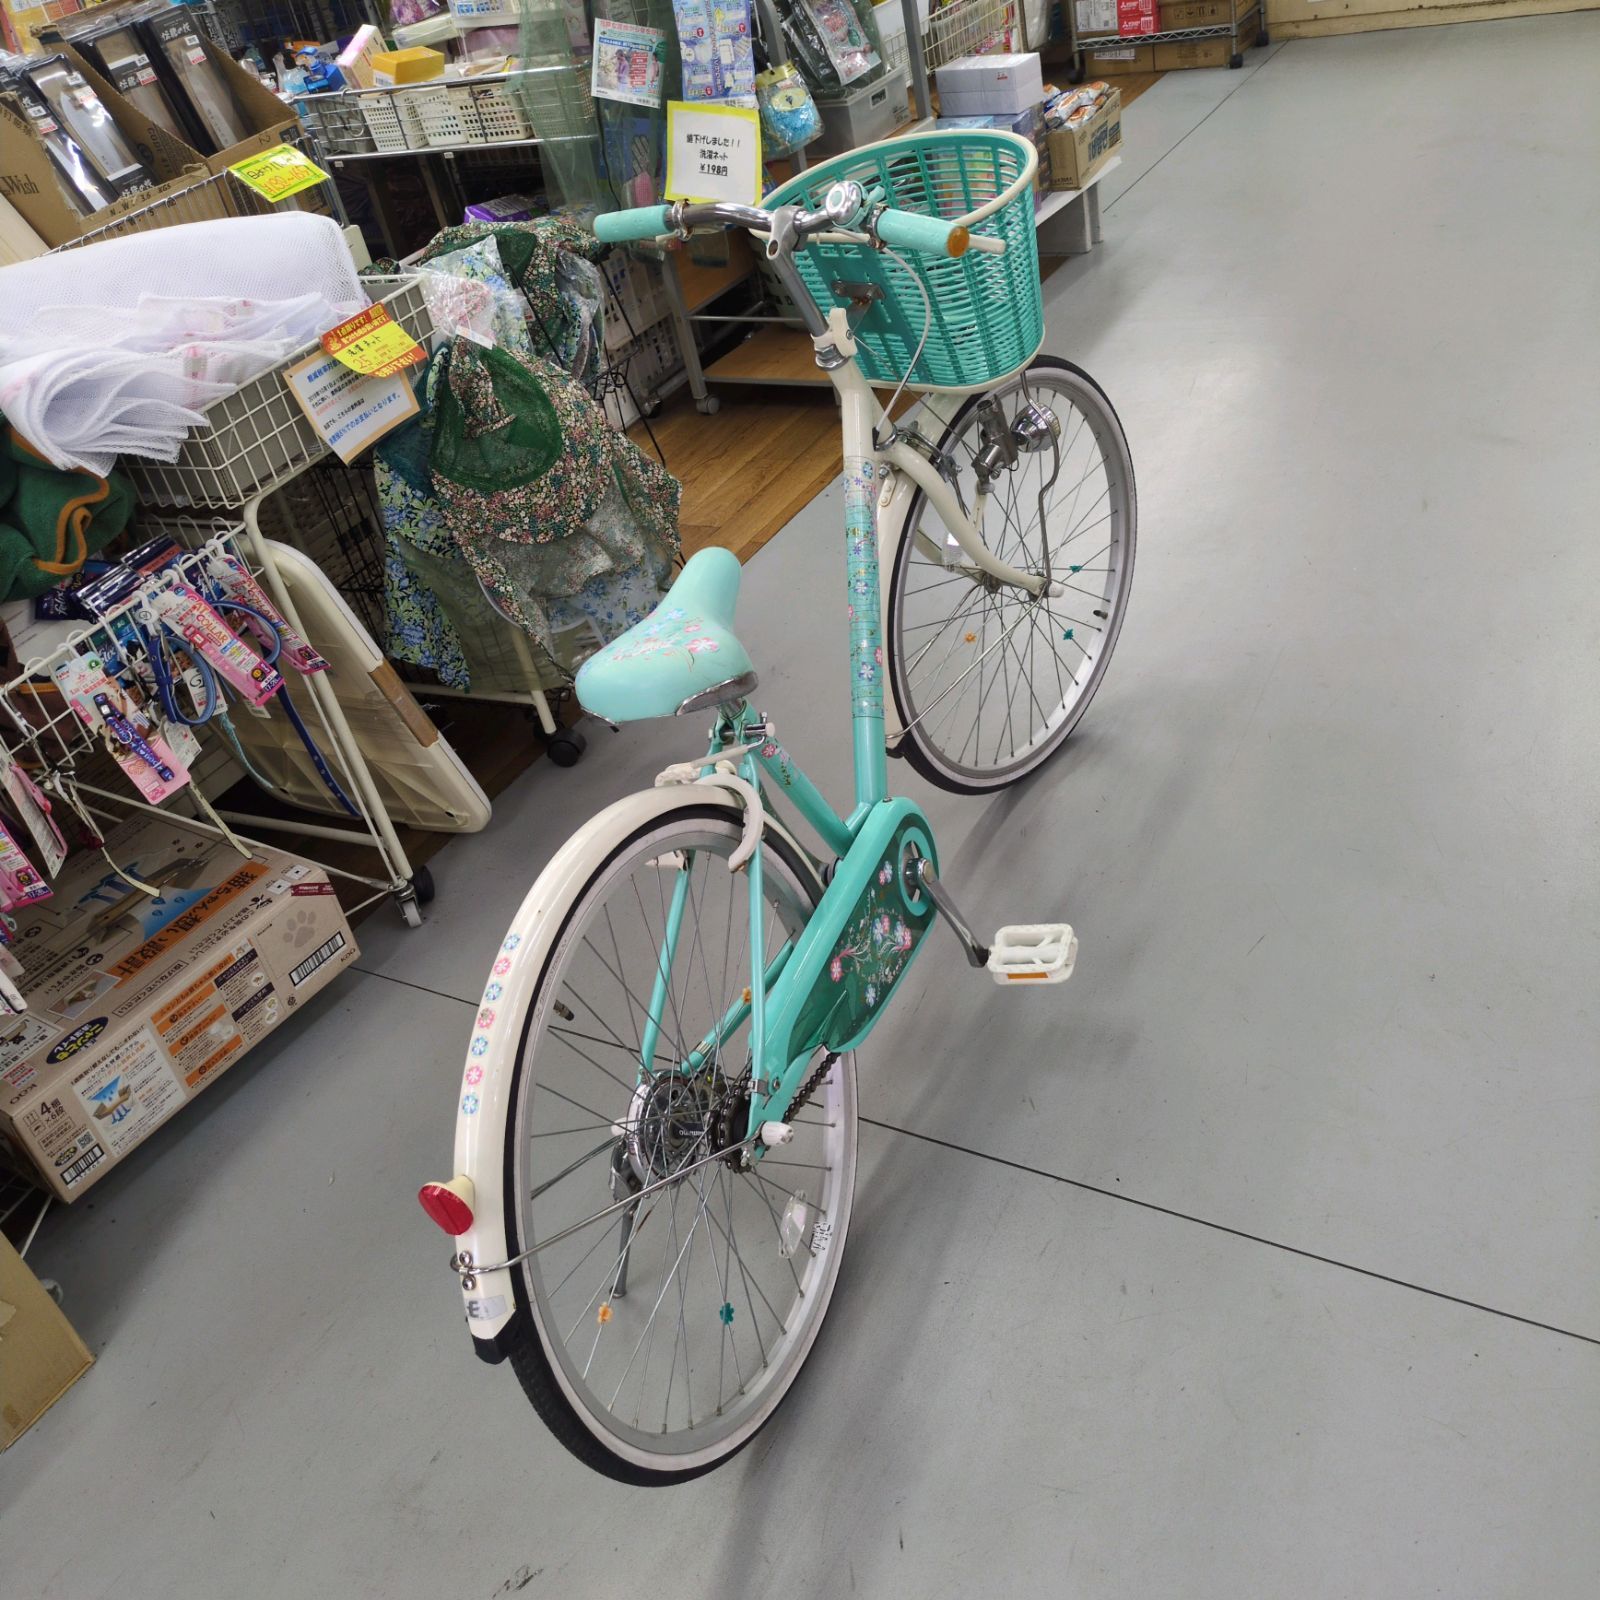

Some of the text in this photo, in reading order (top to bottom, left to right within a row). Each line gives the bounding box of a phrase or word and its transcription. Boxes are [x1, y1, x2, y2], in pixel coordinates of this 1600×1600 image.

[699, 149, 729, 161] 洗濯ネット
[195, 613, 228, 643] COLLAR
[114, 870, 258, 979] 猫ちゃん想い設計
